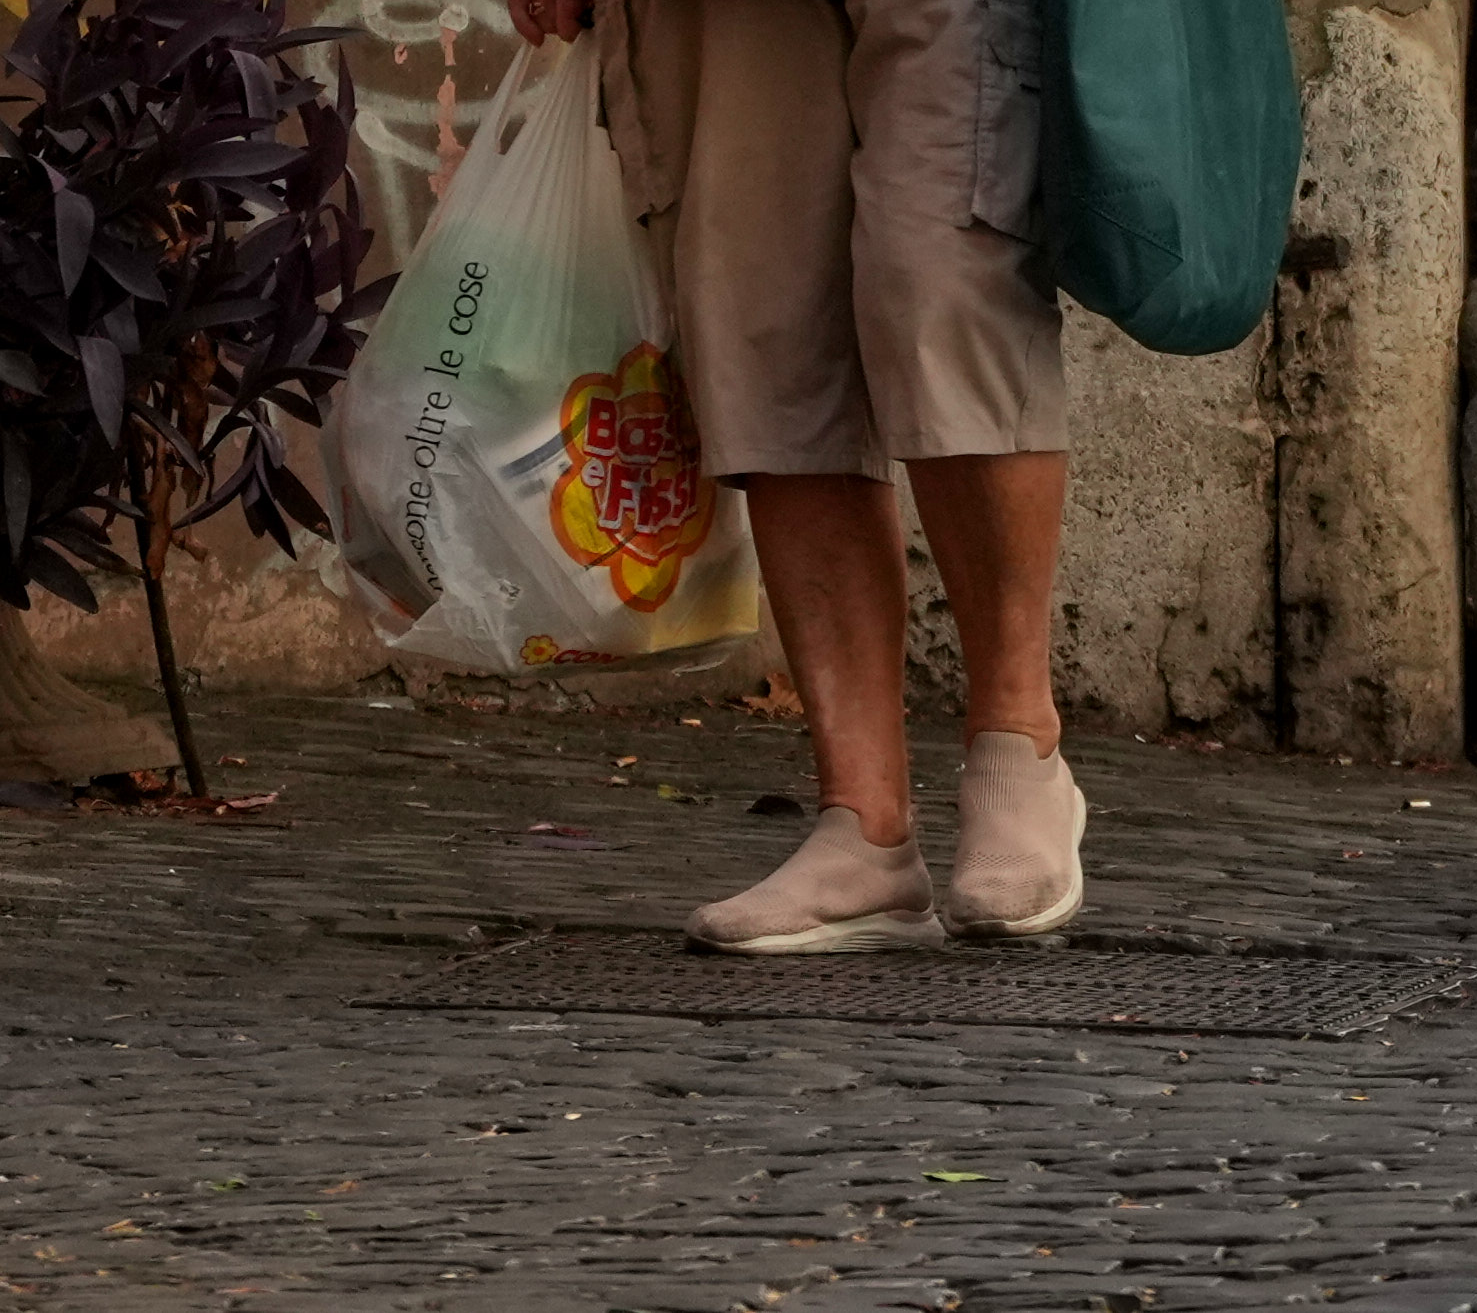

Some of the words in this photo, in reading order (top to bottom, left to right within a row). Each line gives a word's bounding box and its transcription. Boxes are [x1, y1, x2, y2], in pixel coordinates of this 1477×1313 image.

[448, 261, 489, 336] cose
[424, 349, 464, 380] le
[405, 391, 452, 470] oltre
[581, 458, 606, 488] e
